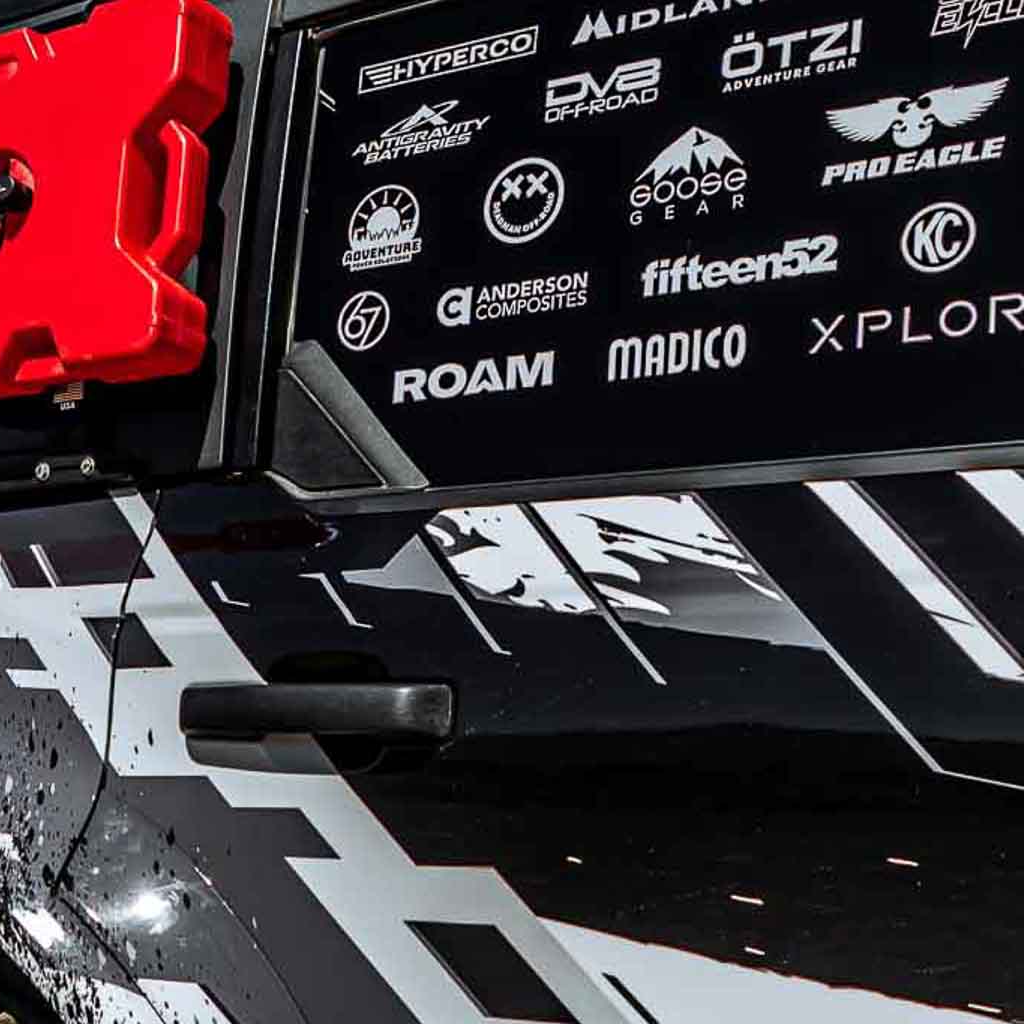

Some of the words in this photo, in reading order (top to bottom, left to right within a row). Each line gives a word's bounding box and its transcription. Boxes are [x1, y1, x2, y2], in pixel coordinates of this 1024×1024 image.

[721, 18, 863, 79] ÖTZI
[546, 58, 662, 107] DV8
[722, 67, 810, 93] ADVENTURE
[816, 57, 857, 74] GEAR
[544, 87, 659, 123] OFFROAD
[352, 115, 490, 157] ANTIGRAVITY
[364, 134, 471, 165] BATTERIES
[821, 156, 891, 187] PRO
[893, 136, 1006, 176] EAGLE
[630, 168, 747, 207] GOOSE
[630, 194, 745, 226] GEAR
[344, 241, 421, 263] ADVENTURE
[913, 210, 964, 264] KC
[640, 234, 839, 298] fifteen52
[476, 272, 589, 304] ANDERSON
[476, 289, 588, 321] COMPOSITES
[342, 292, 383, 349] 67
[607, 324, 747, 382] MADICO
[392, 350, 555, 404] ROAM
